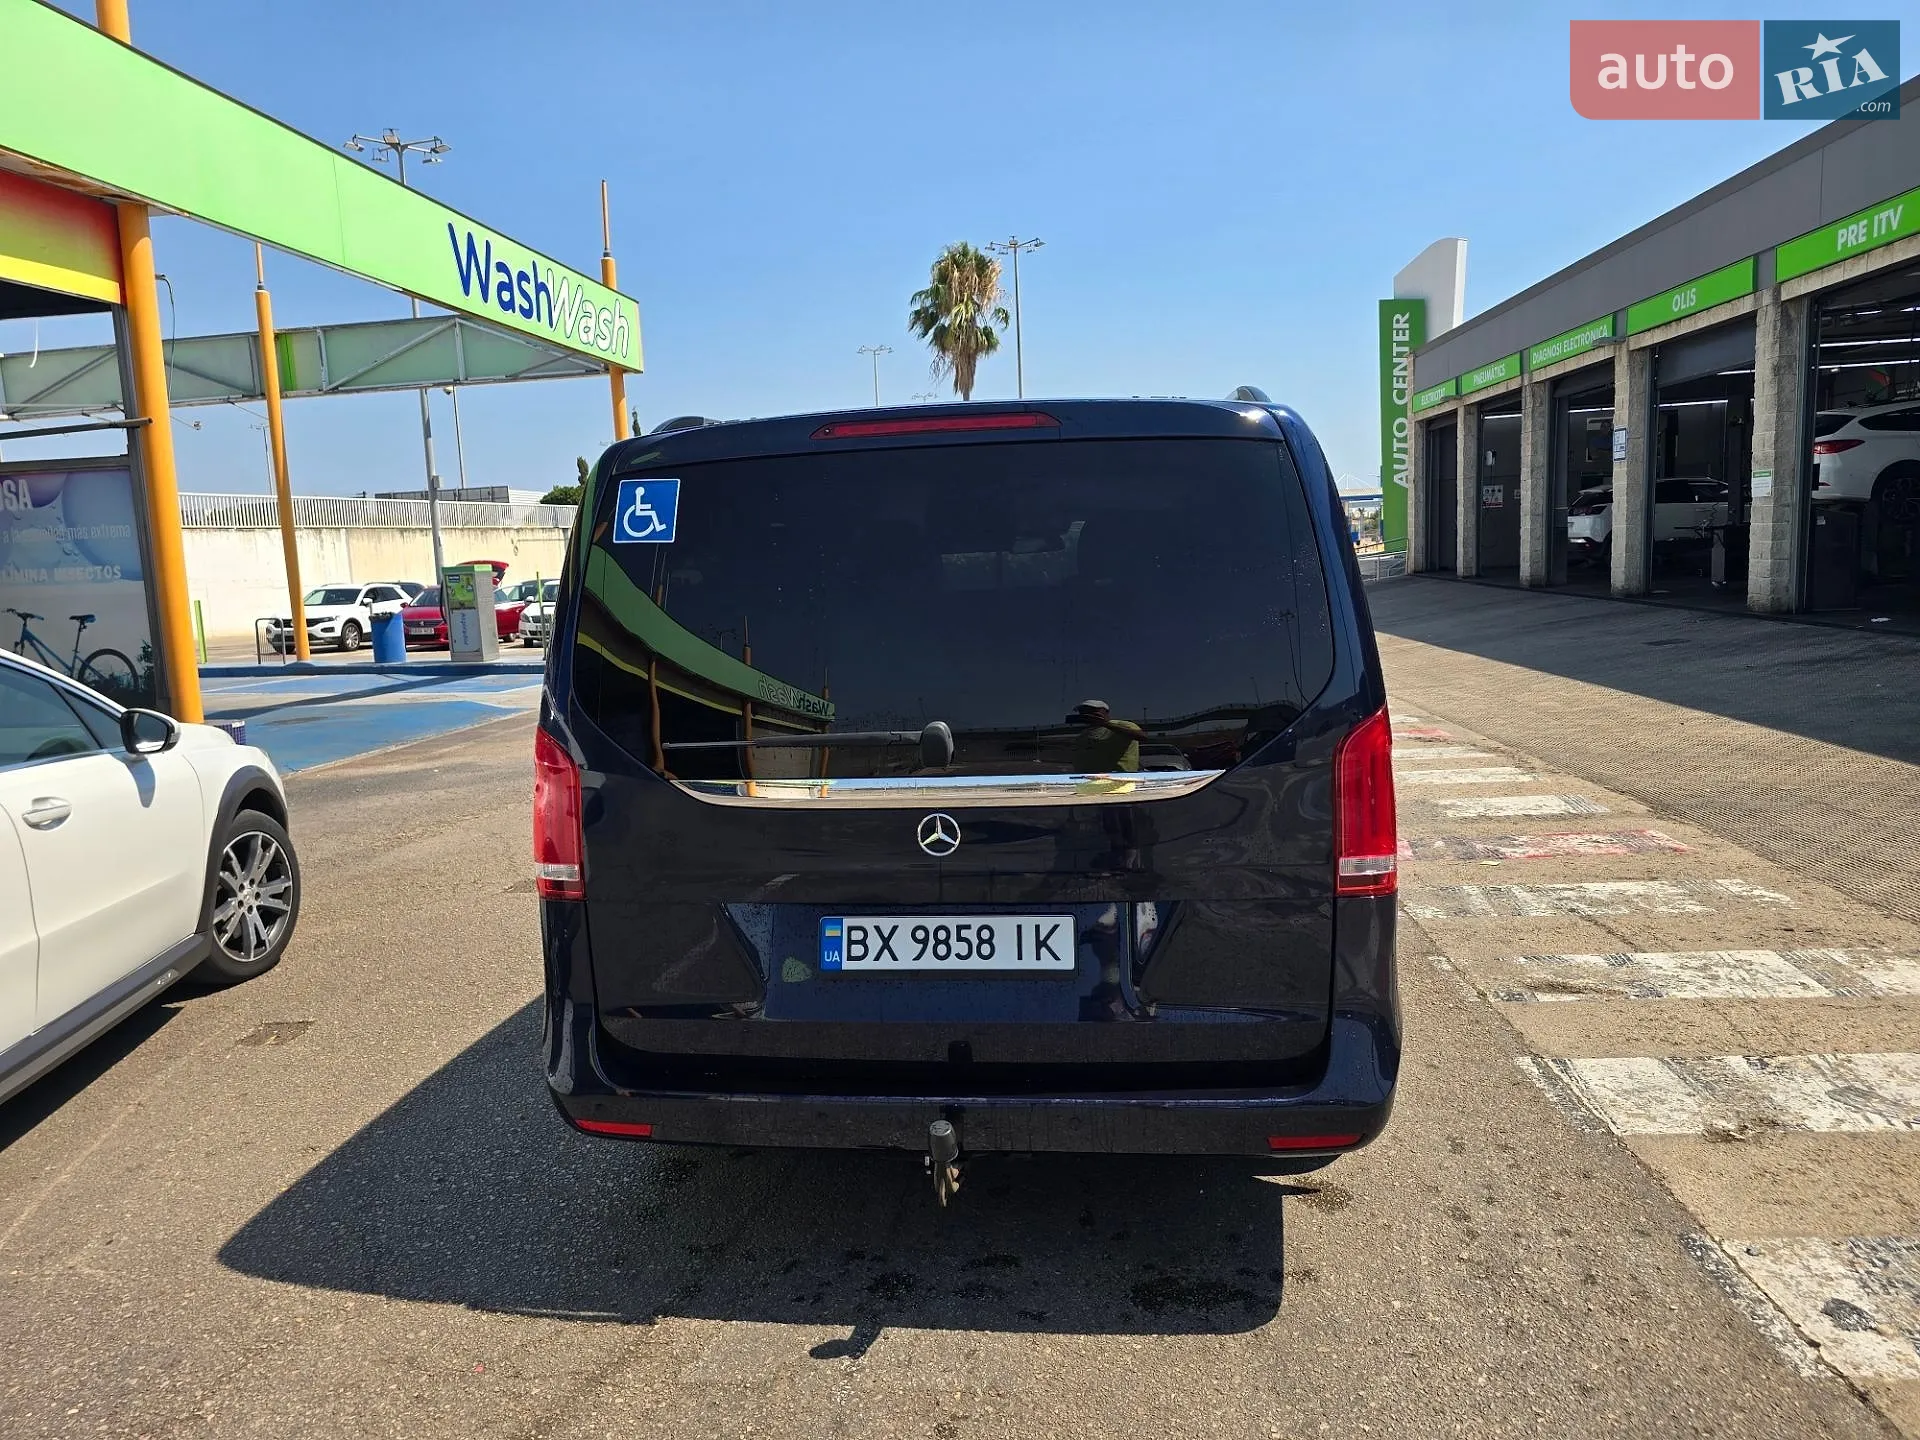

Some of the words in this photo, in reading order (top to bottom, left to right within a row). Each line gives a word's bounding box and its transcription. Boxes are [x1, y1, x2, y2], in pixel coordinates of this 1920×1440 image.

[1836, 219, 1867, 252] PRE
[1872, 204, 1904, 238] ITV
[1671, 287, 1697, 313] OLIS
[1393, 312, 1410, 406] CENTER
[1393, 417, 1409, 489] AUTO
[0, 479, 33, 511] SA
[824, 950, 840, 962] UA
[846, 924, 899, 961] BX
[910, 924, 996, 961] 9858
